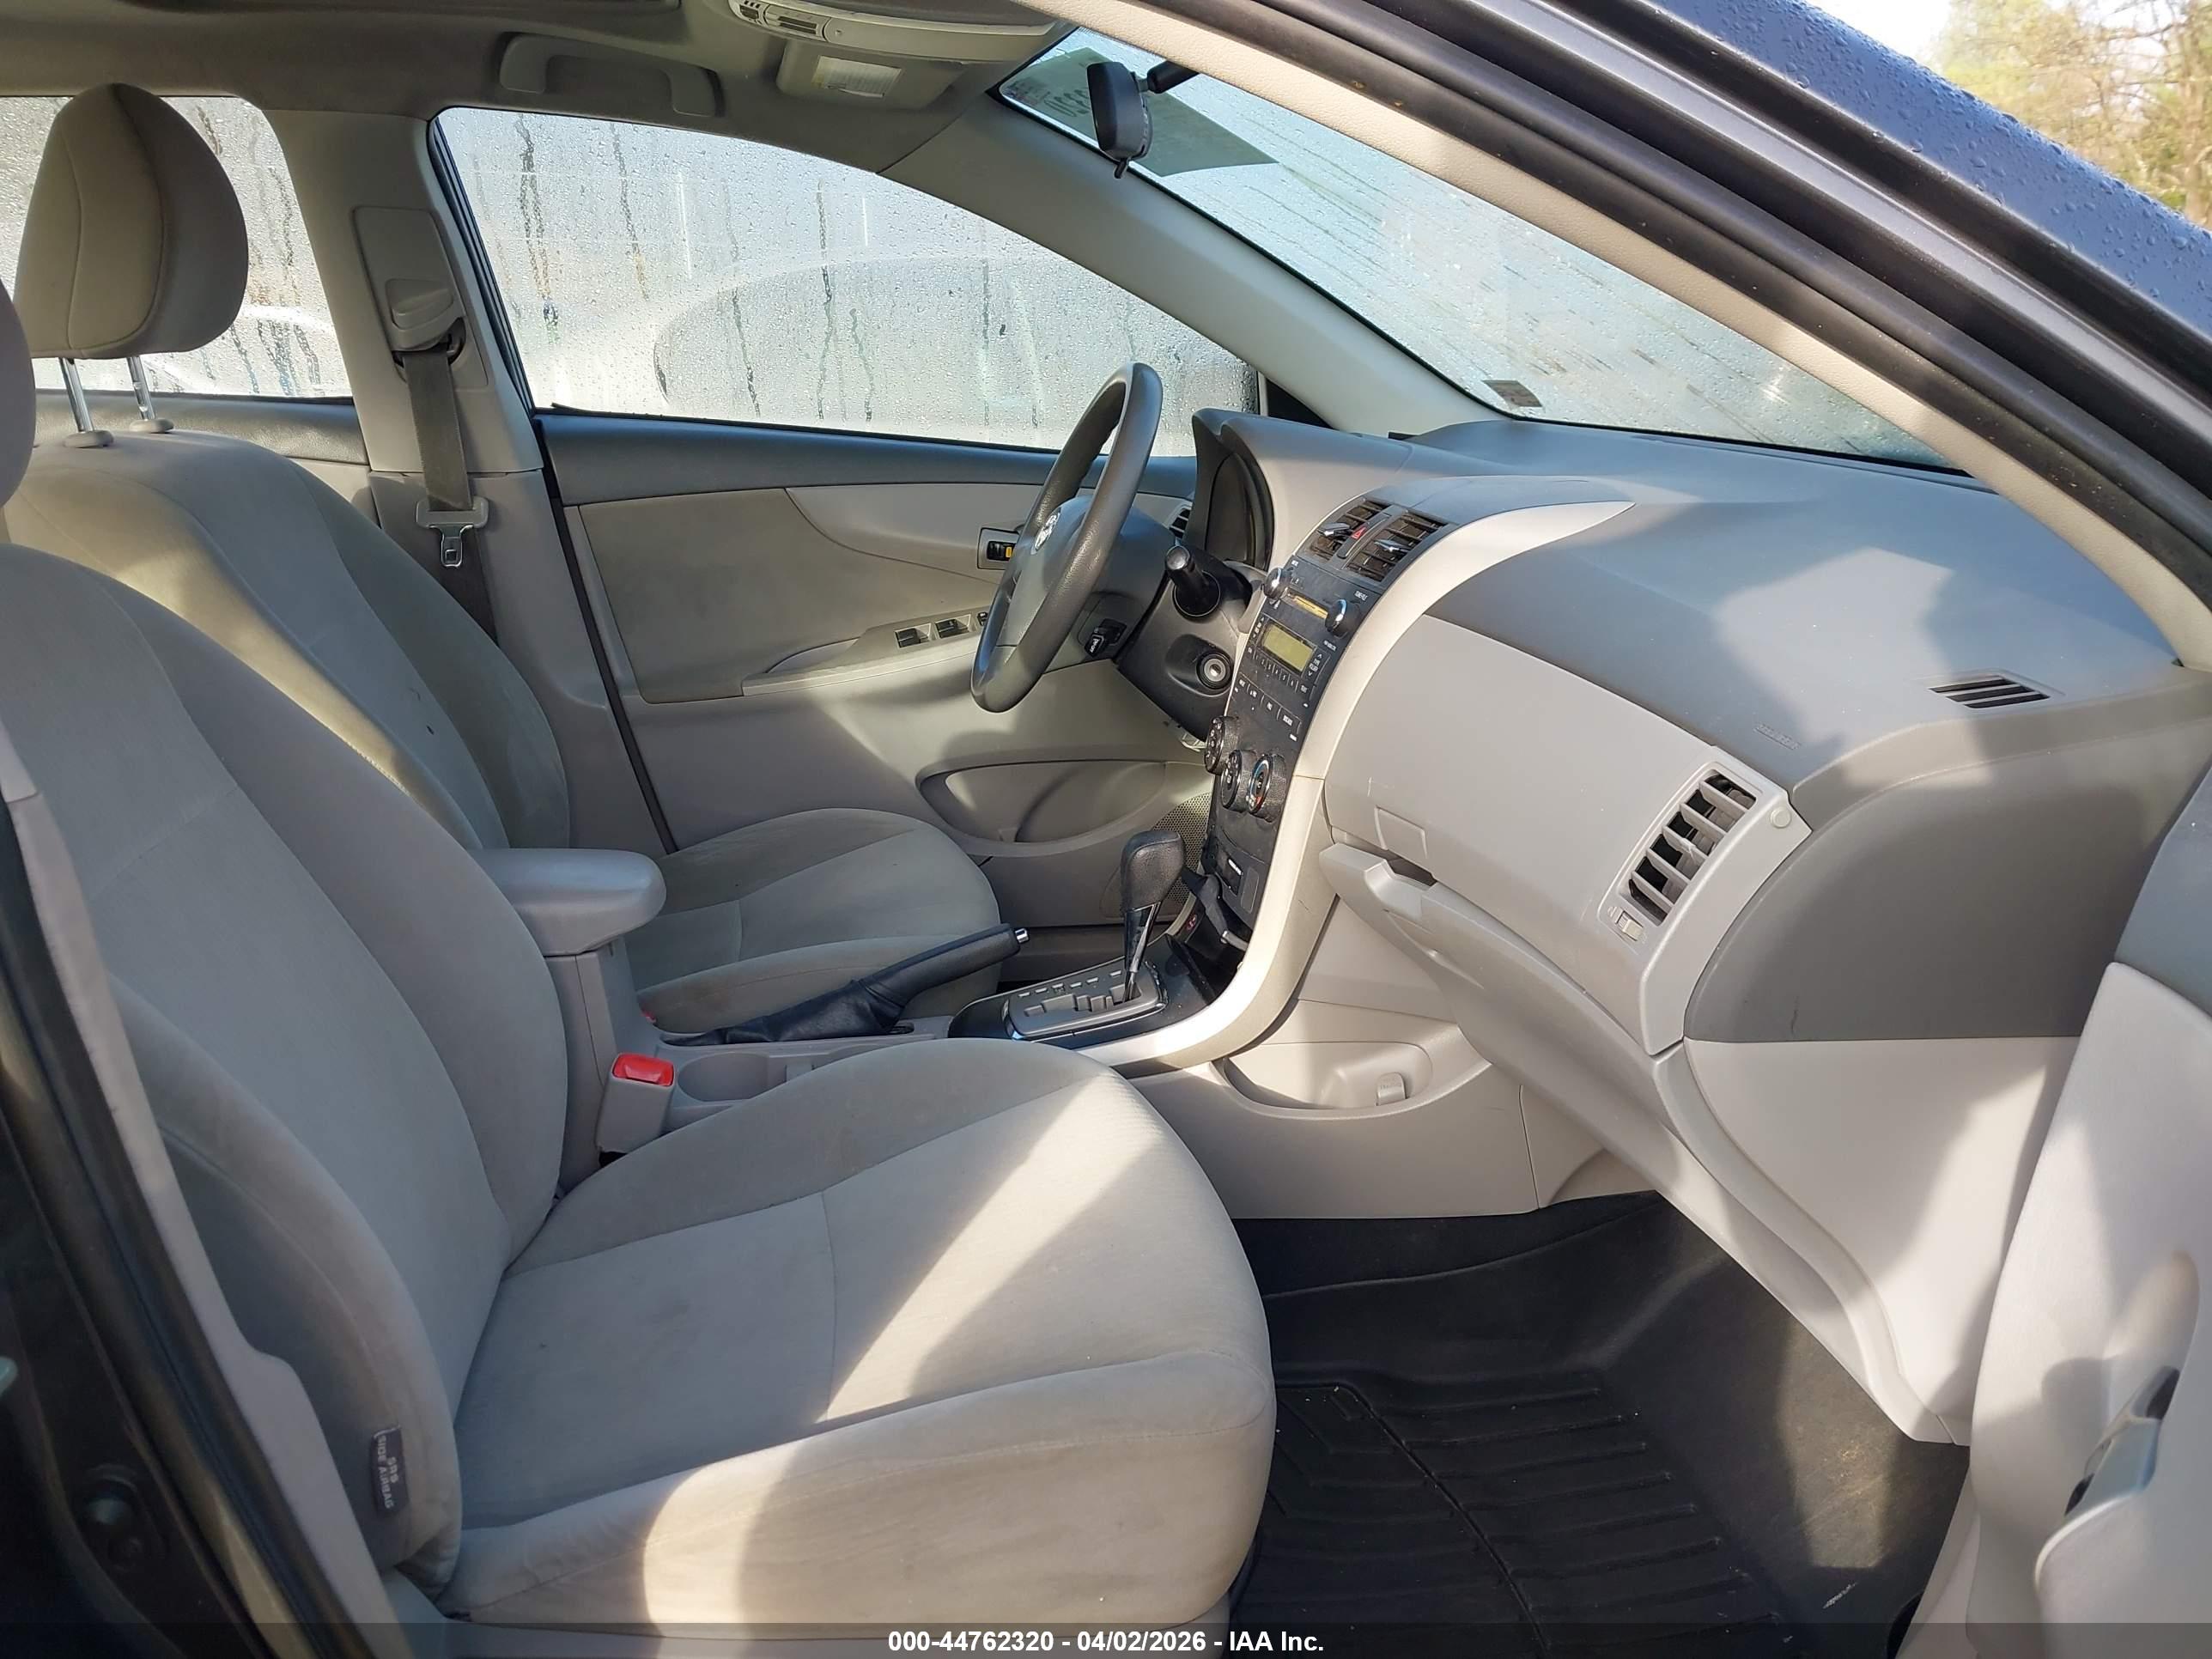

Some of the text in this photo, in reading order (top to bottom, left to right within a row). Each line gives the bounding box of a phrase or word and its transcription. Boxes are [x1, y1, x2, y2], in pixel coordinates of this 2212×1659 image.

[378, 1435, 394, 1509] SIDE AIRBAG
[386, 1456, 399, 1483] SRS
